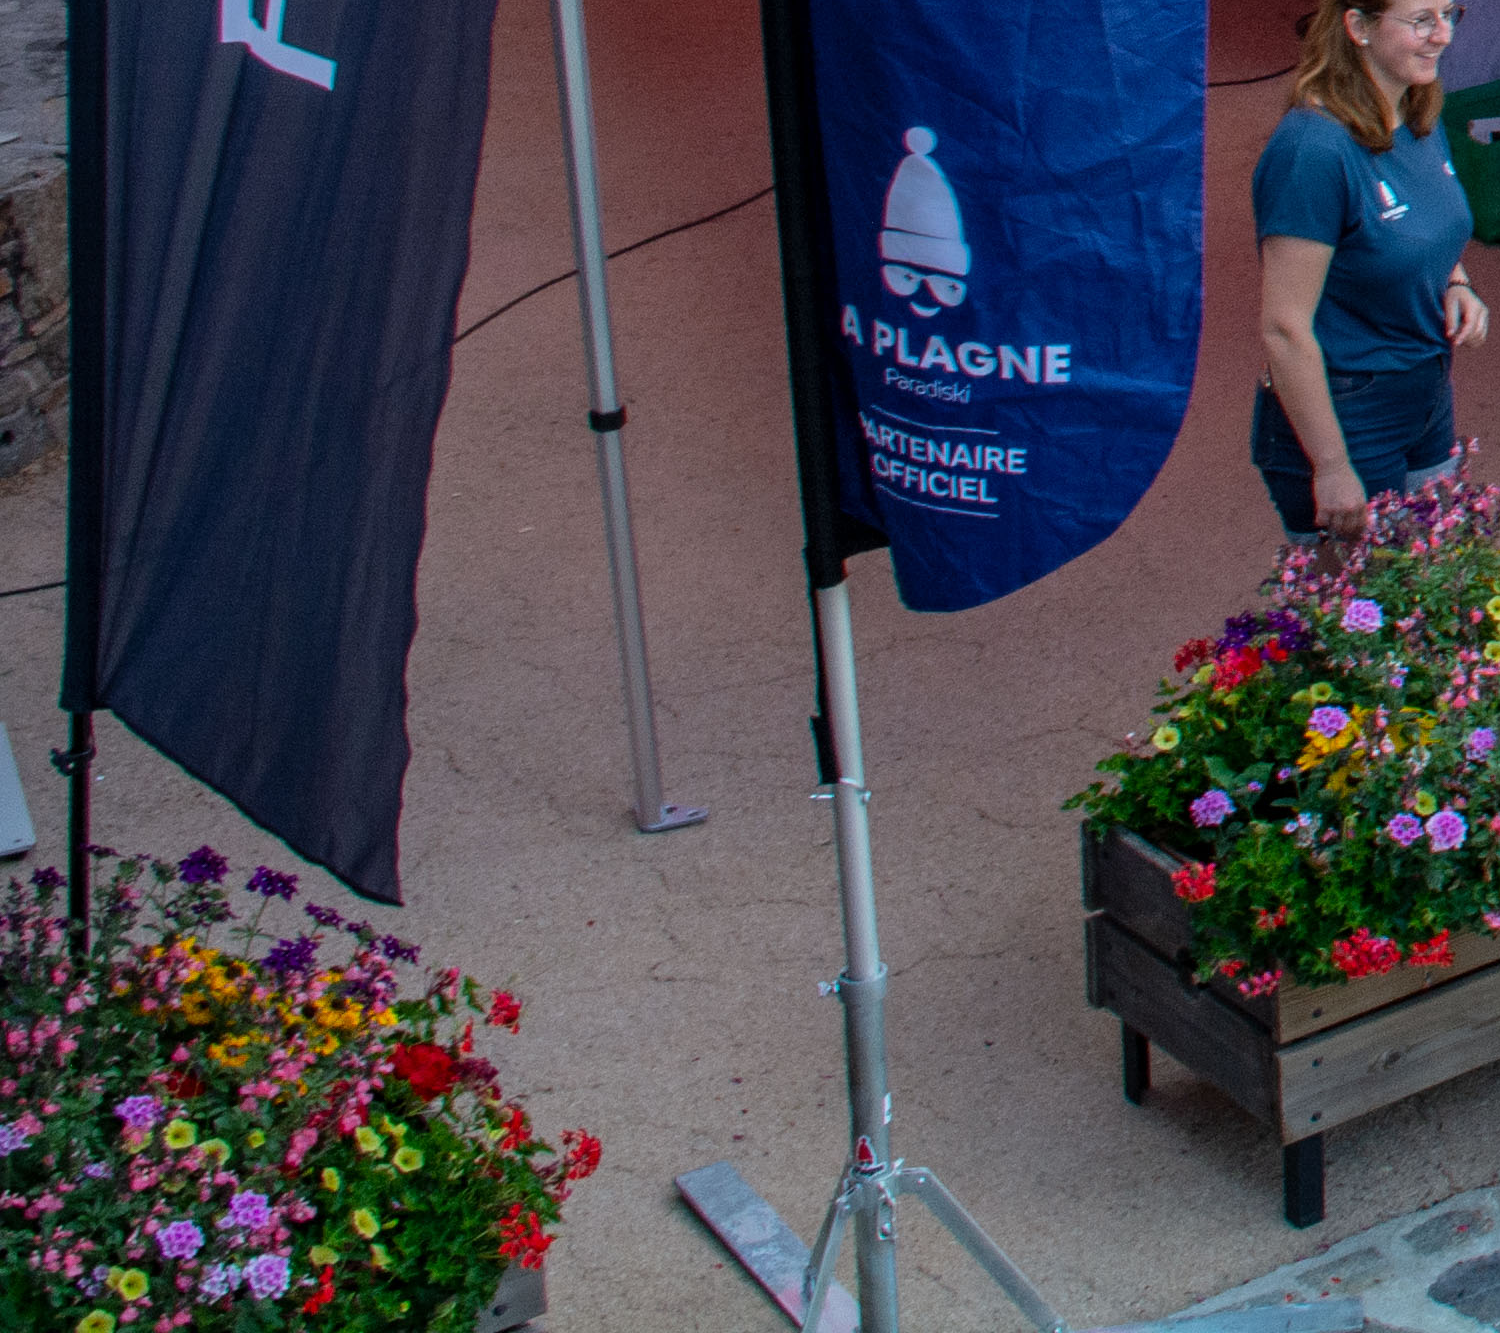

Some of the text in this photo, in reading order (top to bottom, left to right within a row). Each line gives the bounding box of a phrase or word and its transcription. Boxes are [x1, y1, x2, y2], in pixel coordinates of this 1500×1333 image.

[872, 319, 1072, 385] PLAGNE
[885, 367, 972, 405] Paradiski
[872, 450, 999, 504] OFFICIEL
